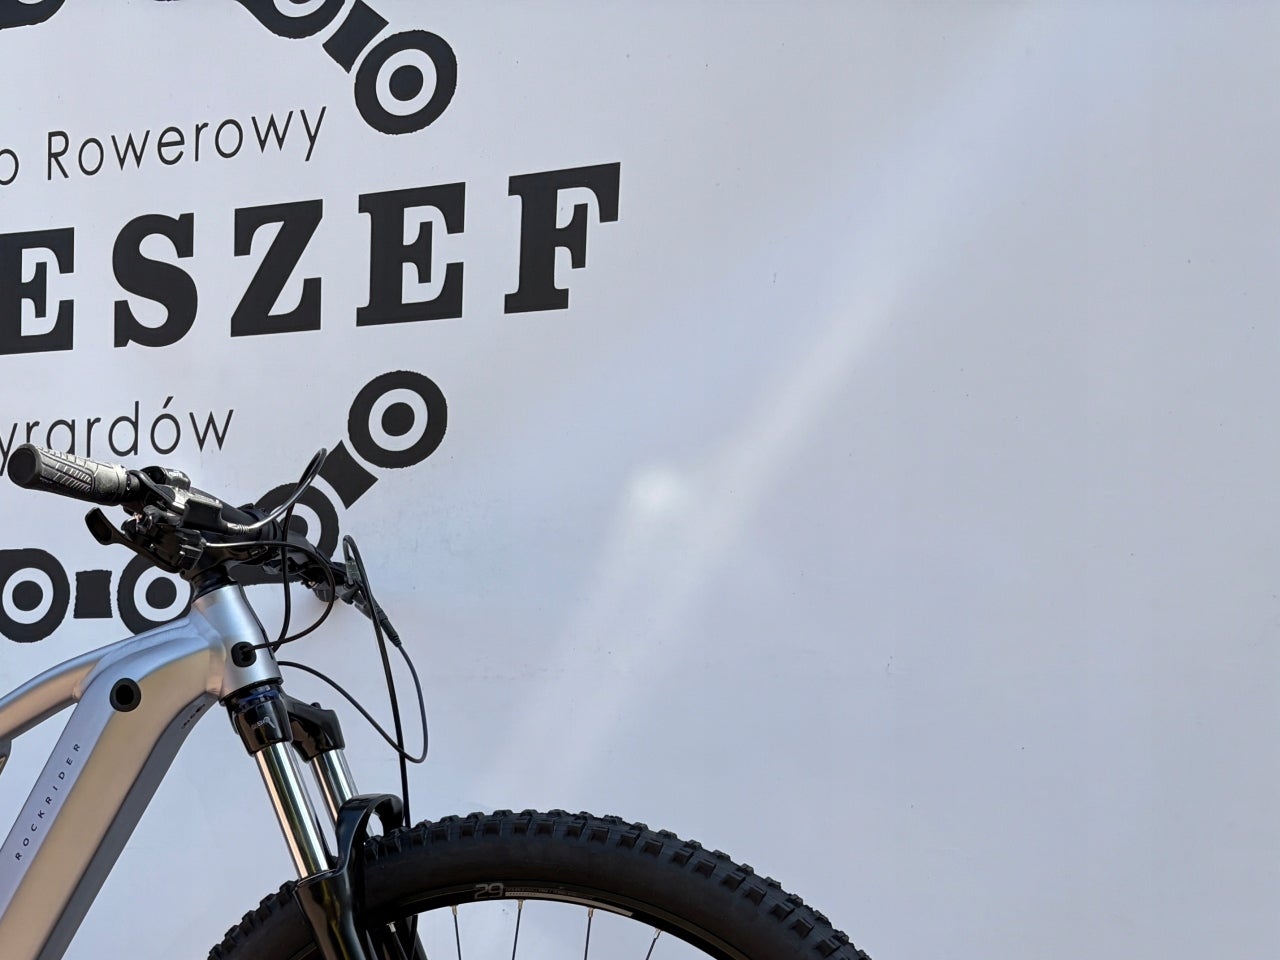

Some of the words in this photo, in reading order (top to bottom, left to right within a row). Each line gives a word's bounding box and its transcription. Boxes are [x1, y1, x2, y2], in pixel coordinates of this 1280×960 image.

[48, 107, 326, 180] Rowerowy
[14, 742, 81, 861] ROCKRIDER
[474, 882, 505, 900] 29
